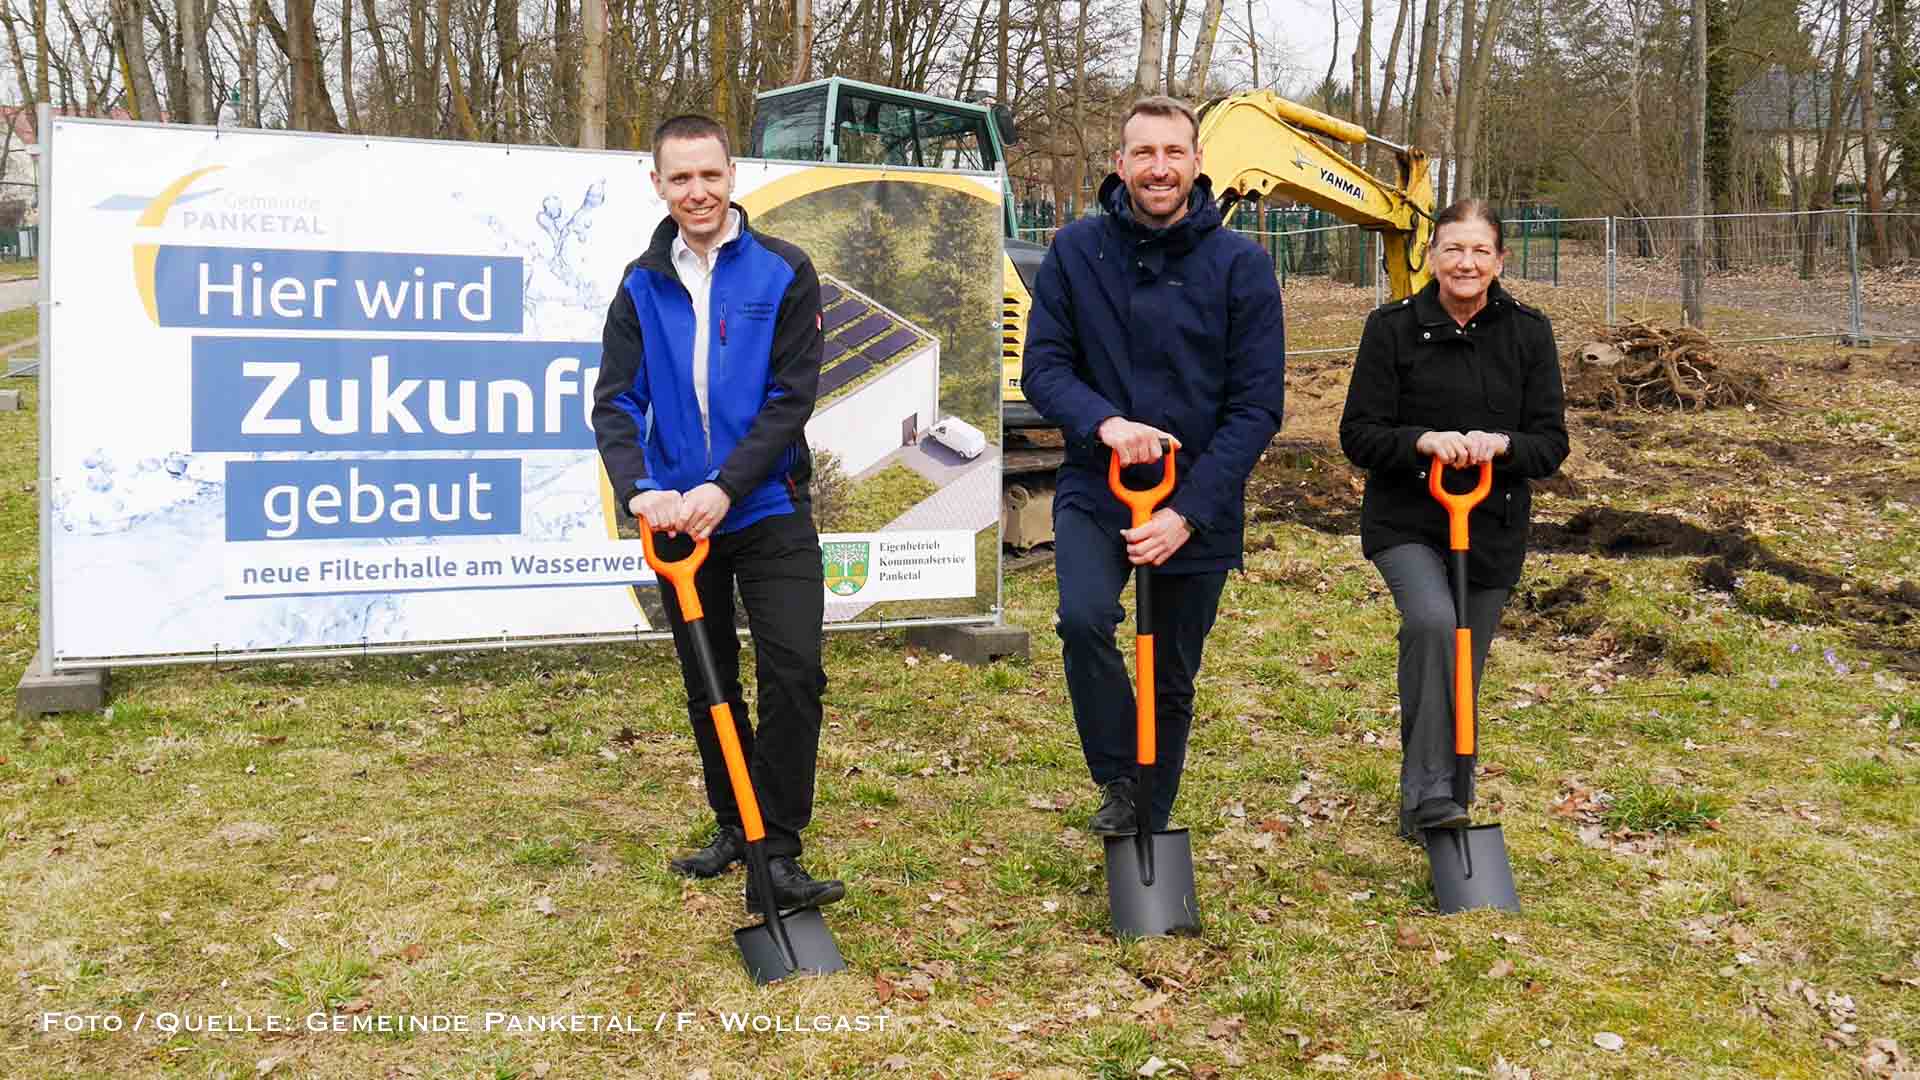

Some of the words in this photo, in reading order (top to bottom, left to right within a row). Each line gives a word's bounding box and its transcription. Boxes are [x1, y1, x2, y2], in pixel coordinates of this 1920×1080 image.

[183, 210, 328, 235] PANKETAL
[197, 262, 337, 319] Hier
[355, 266, 492, 322] wird
[263, 466, 493, 538] gebaut
[879, 540, 940, 552] Eigenbetrieb
[242, 564, 310, 585] neue
[319, 555, 457, 582] Filterhalle
[465, 558, 503, 576] am
[511, 554, 644, 575] Wasserwer
[879, 554, 966, 567] Kommunalservice
[879, 570, 921, 581] Panketal
